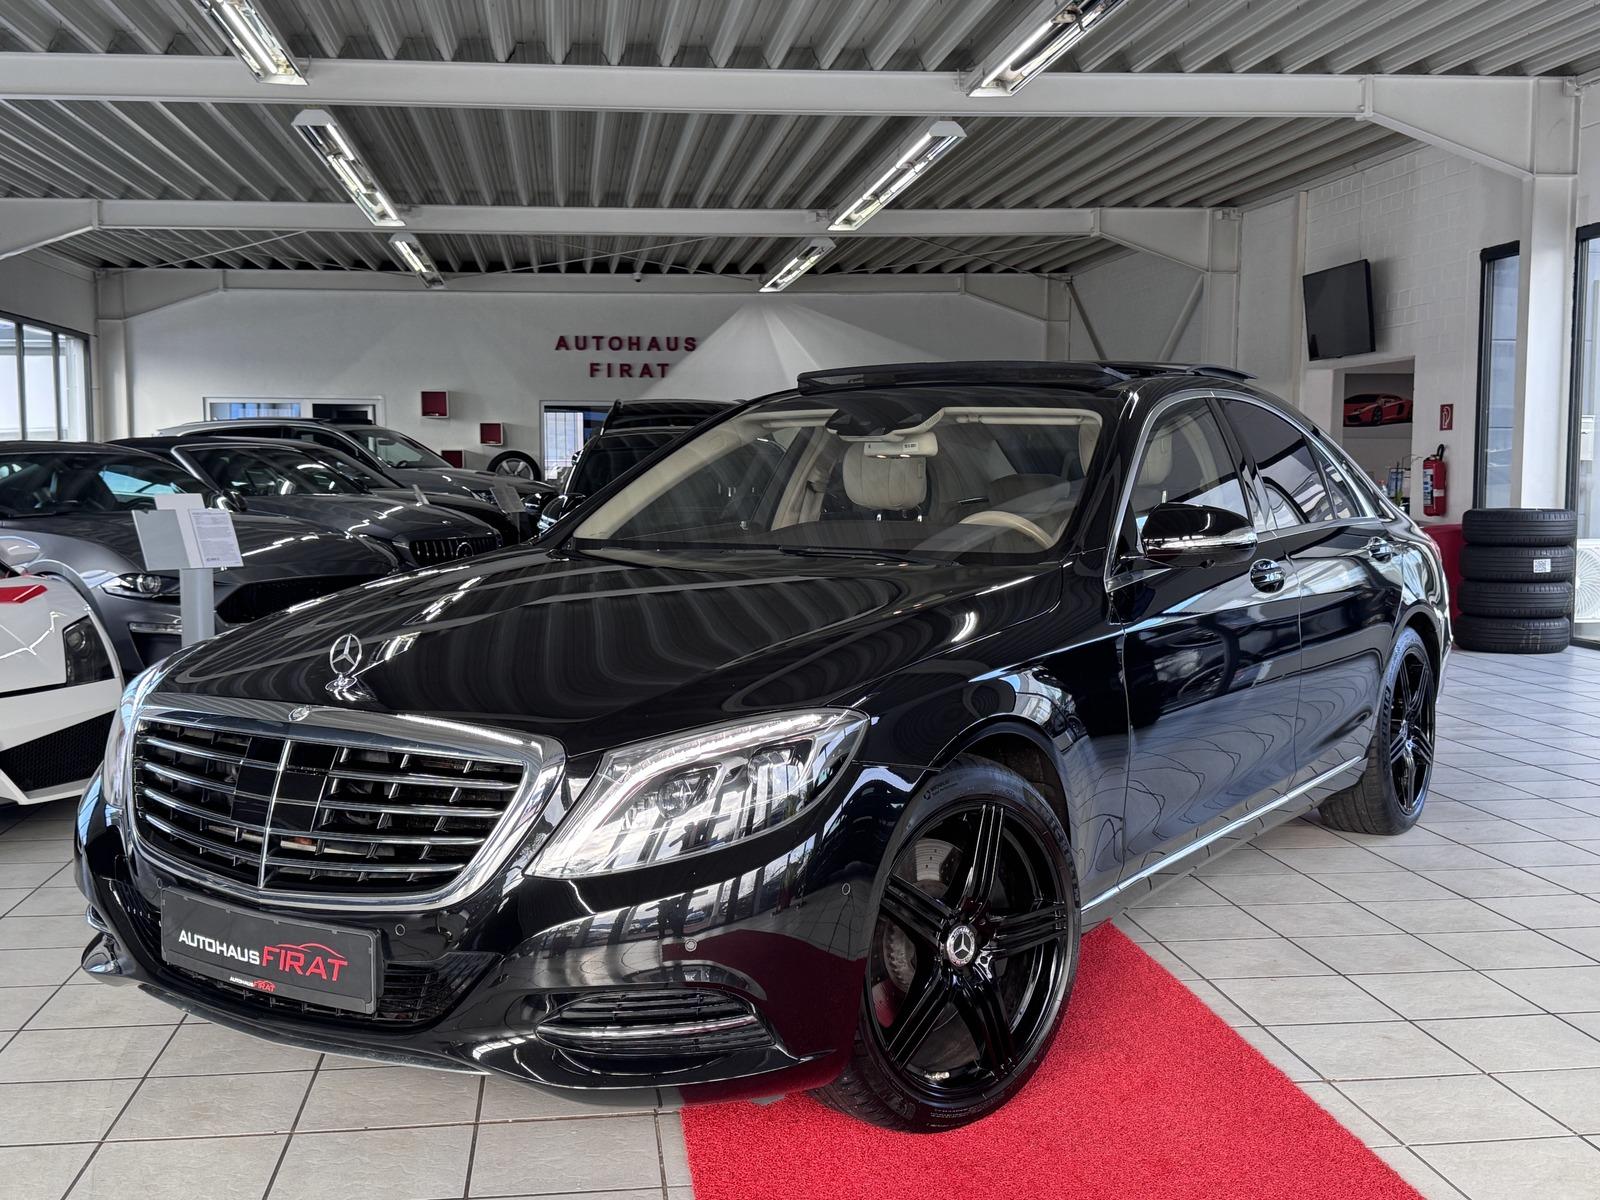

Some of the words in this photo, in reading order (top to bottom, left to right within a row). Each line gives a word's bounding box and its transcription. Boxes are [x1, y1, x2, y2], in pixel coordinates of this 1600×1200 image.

[555, 335, 697, 351] AUTOHAUS
[590, 362, 670, 378] FIRAT
[178, 929, 260, 966] AUTOHAUS
[261, 945, 348, 982] FIRAT
